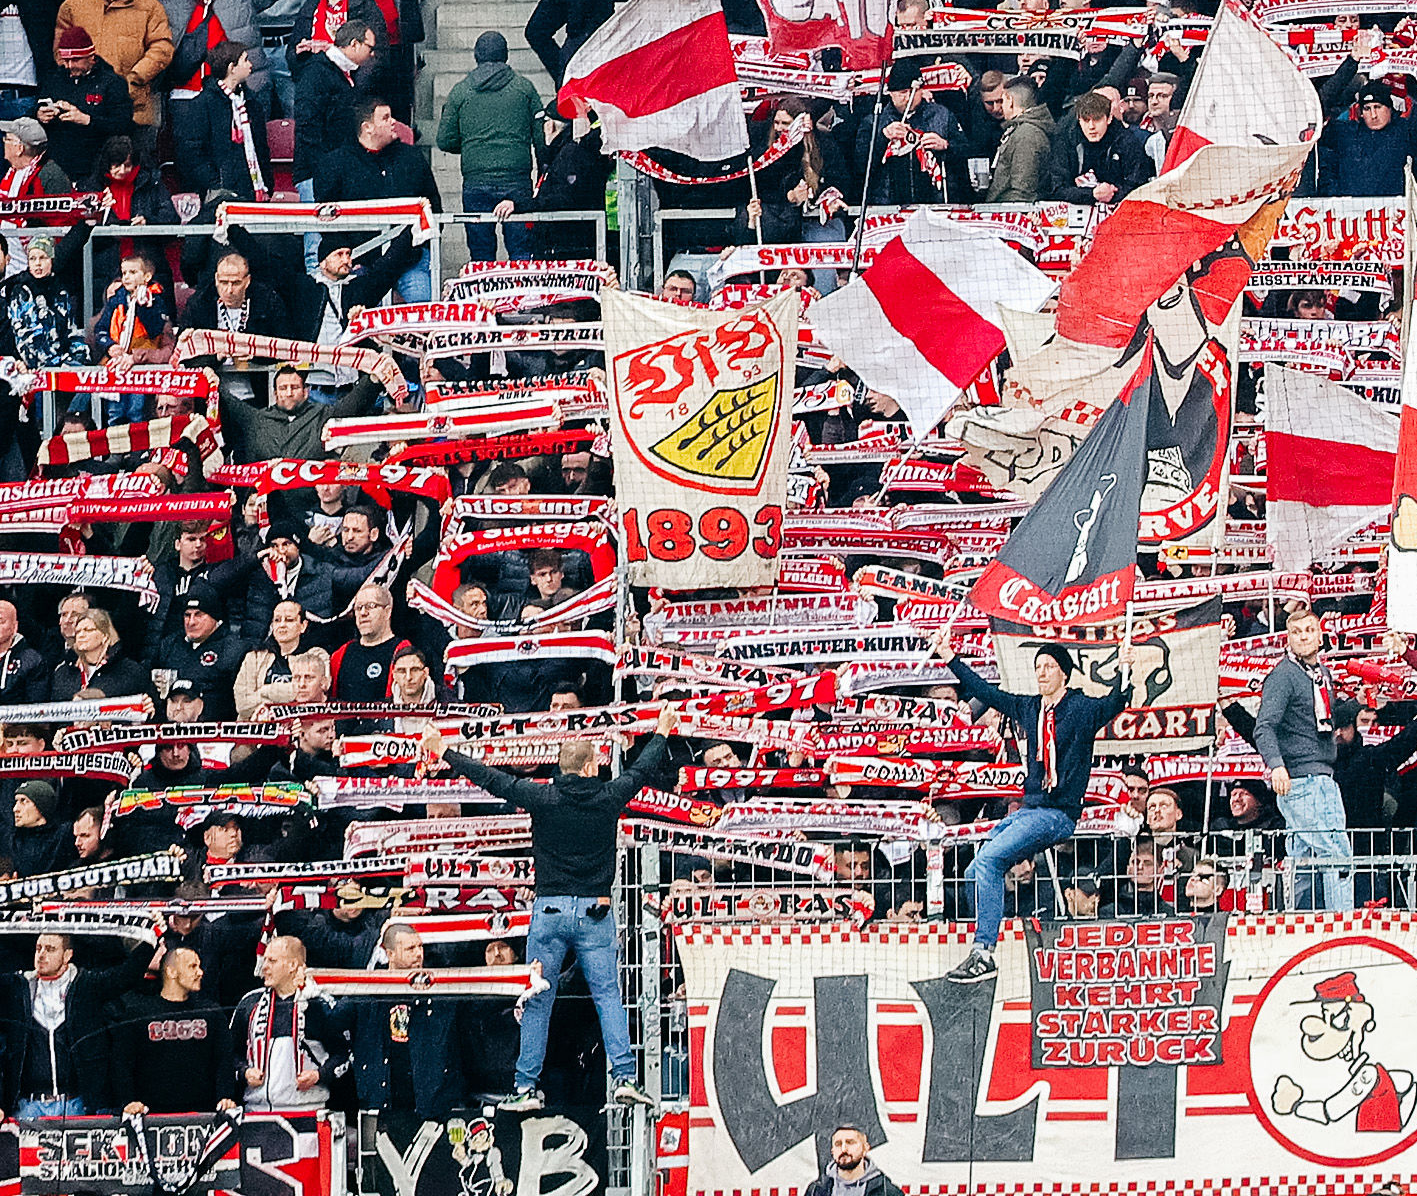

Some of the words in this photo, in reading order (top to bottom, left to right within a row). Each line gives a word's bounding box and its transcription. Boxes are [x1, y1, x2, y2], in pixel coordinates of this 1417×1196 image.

[76, 370, 110, 386] VfB
[115, 370, 201, 390] Stuttgart
[271, 459, 326, 484] CC
[380, 462, 435, 488] 97
[622, 505, 784, 565] 1893
[694, 766, 779, 789] 1997
[1054, 920, 1195, 950] JEDER
[1035, 945, 1215, 982] VERBANNTE
[1054, 979, 1202, 1007] KEHRT
[1036, 1005, 1217, 1038] STÄRKER
[1042, 1034, 1217, 1066] ZURÜCK
